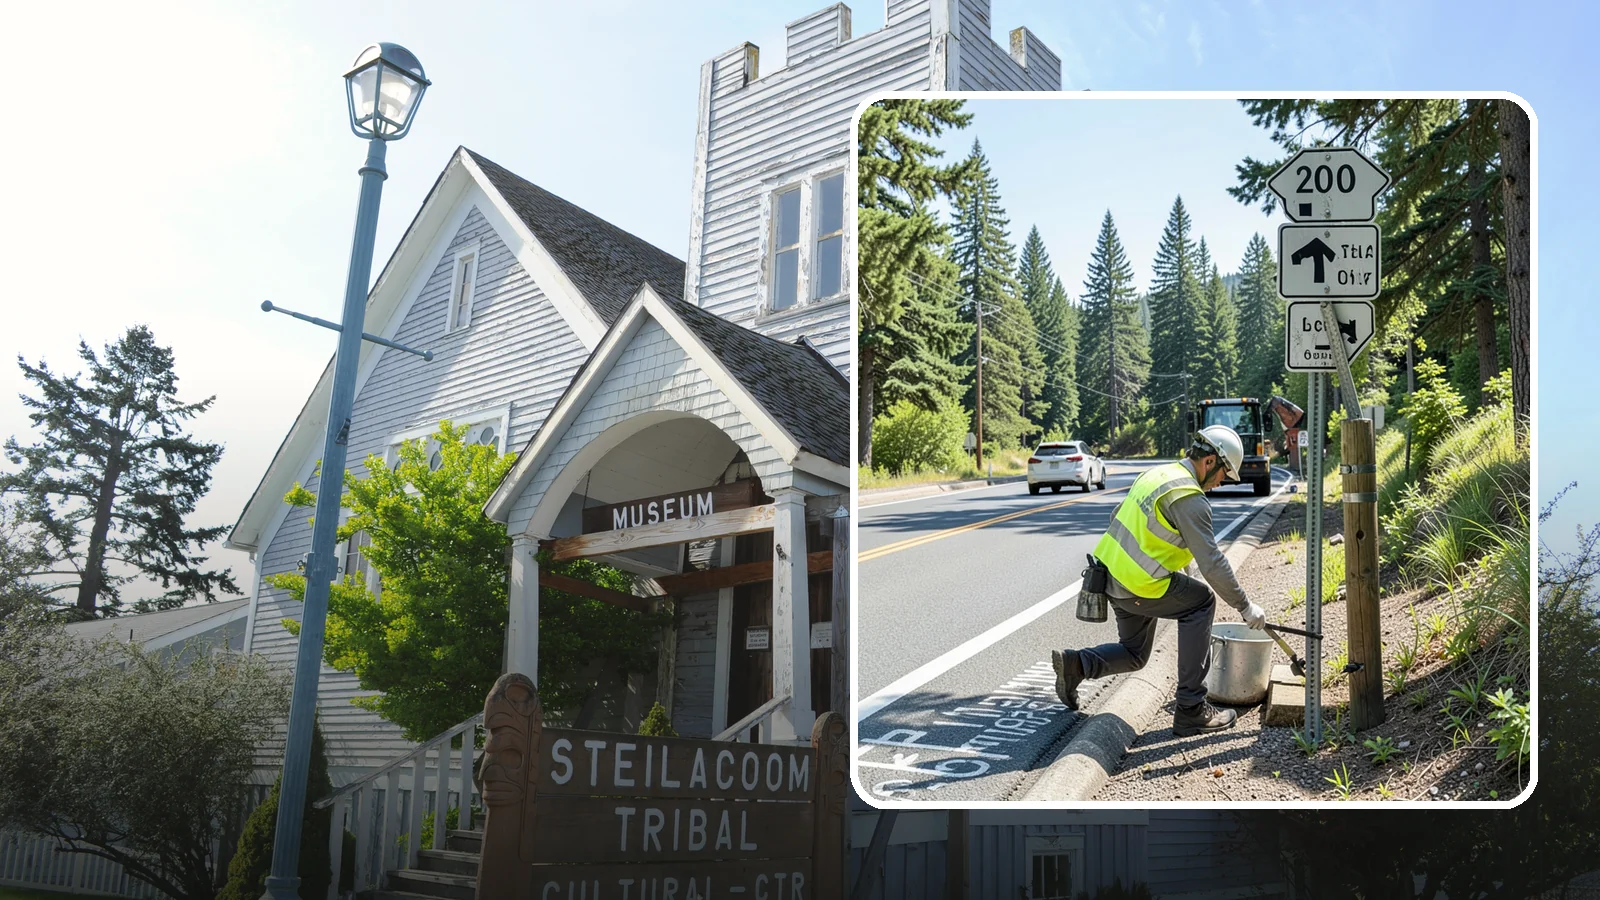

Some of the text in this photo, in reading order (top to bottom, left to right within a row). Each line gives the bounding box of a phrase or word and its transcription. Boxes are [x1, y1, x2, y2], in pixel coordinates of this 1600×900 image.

[1296, 164, 1356, 194] 200
[613, 491, 713, 531] MUSEUM
[550, 738, 809, 793] STEILACOOM
[615, 807, 758, 852] TRIBAL
